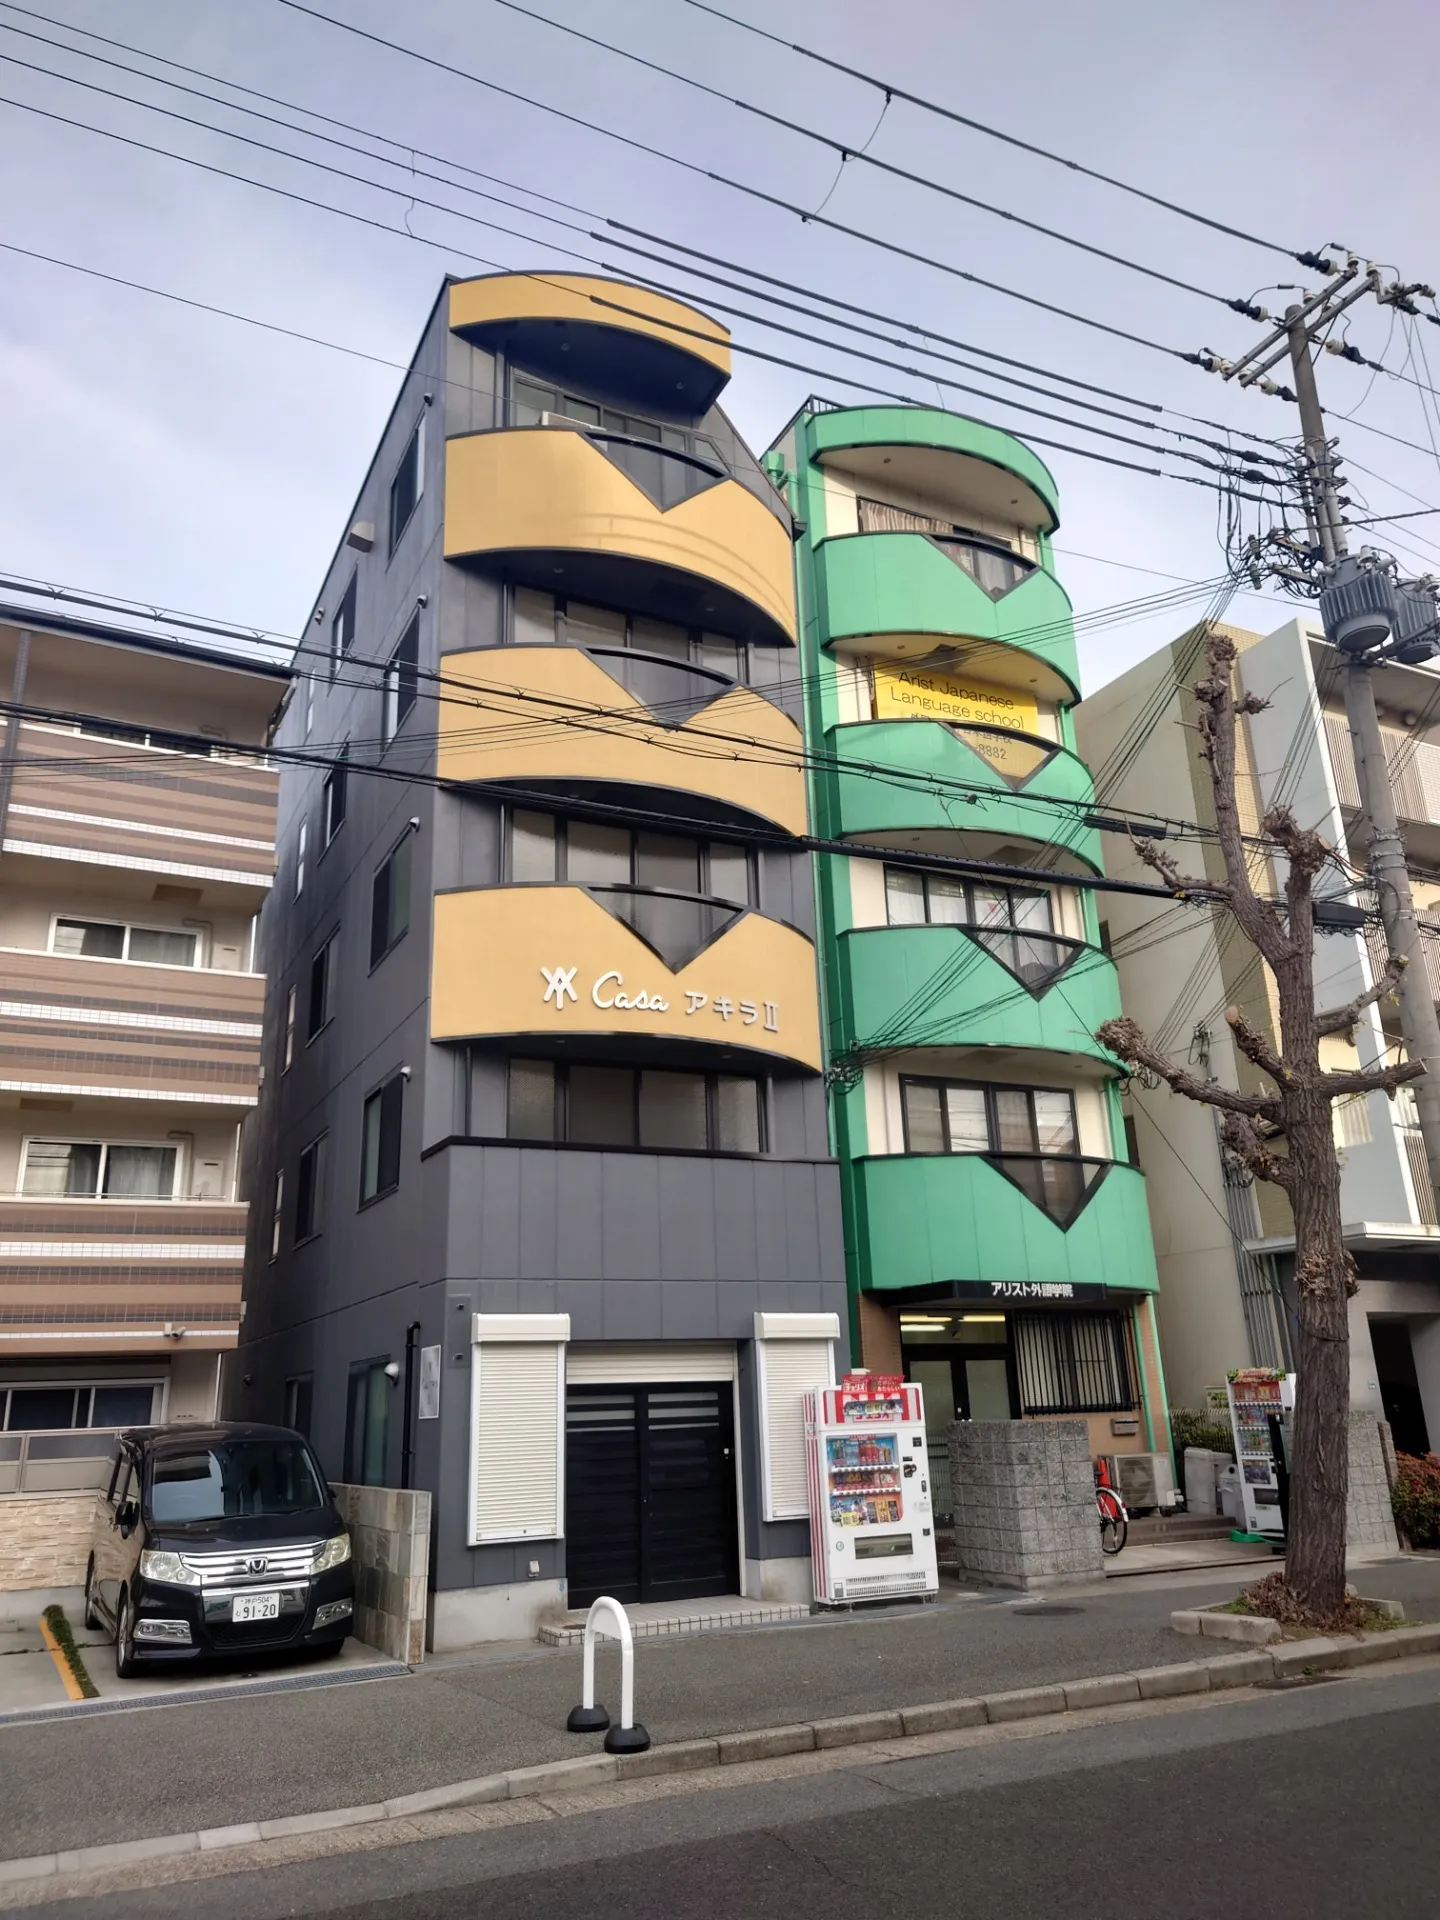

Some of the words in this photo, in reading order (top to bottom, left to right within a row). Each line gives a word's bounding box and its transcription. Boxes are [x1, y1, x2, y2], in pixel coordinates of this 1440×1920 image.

[890, 685, 971, 718] Language
[975, 709, 1025, 730] school
[898, 671, 935, 692] Arist
[940, 682, 1015, 710] Japanese
[591, 970, 670, 1012] Casa
[991, 1282, 1074, 1298] アリスト外語学院
[243, 1603, 276, 1619] 91-20
